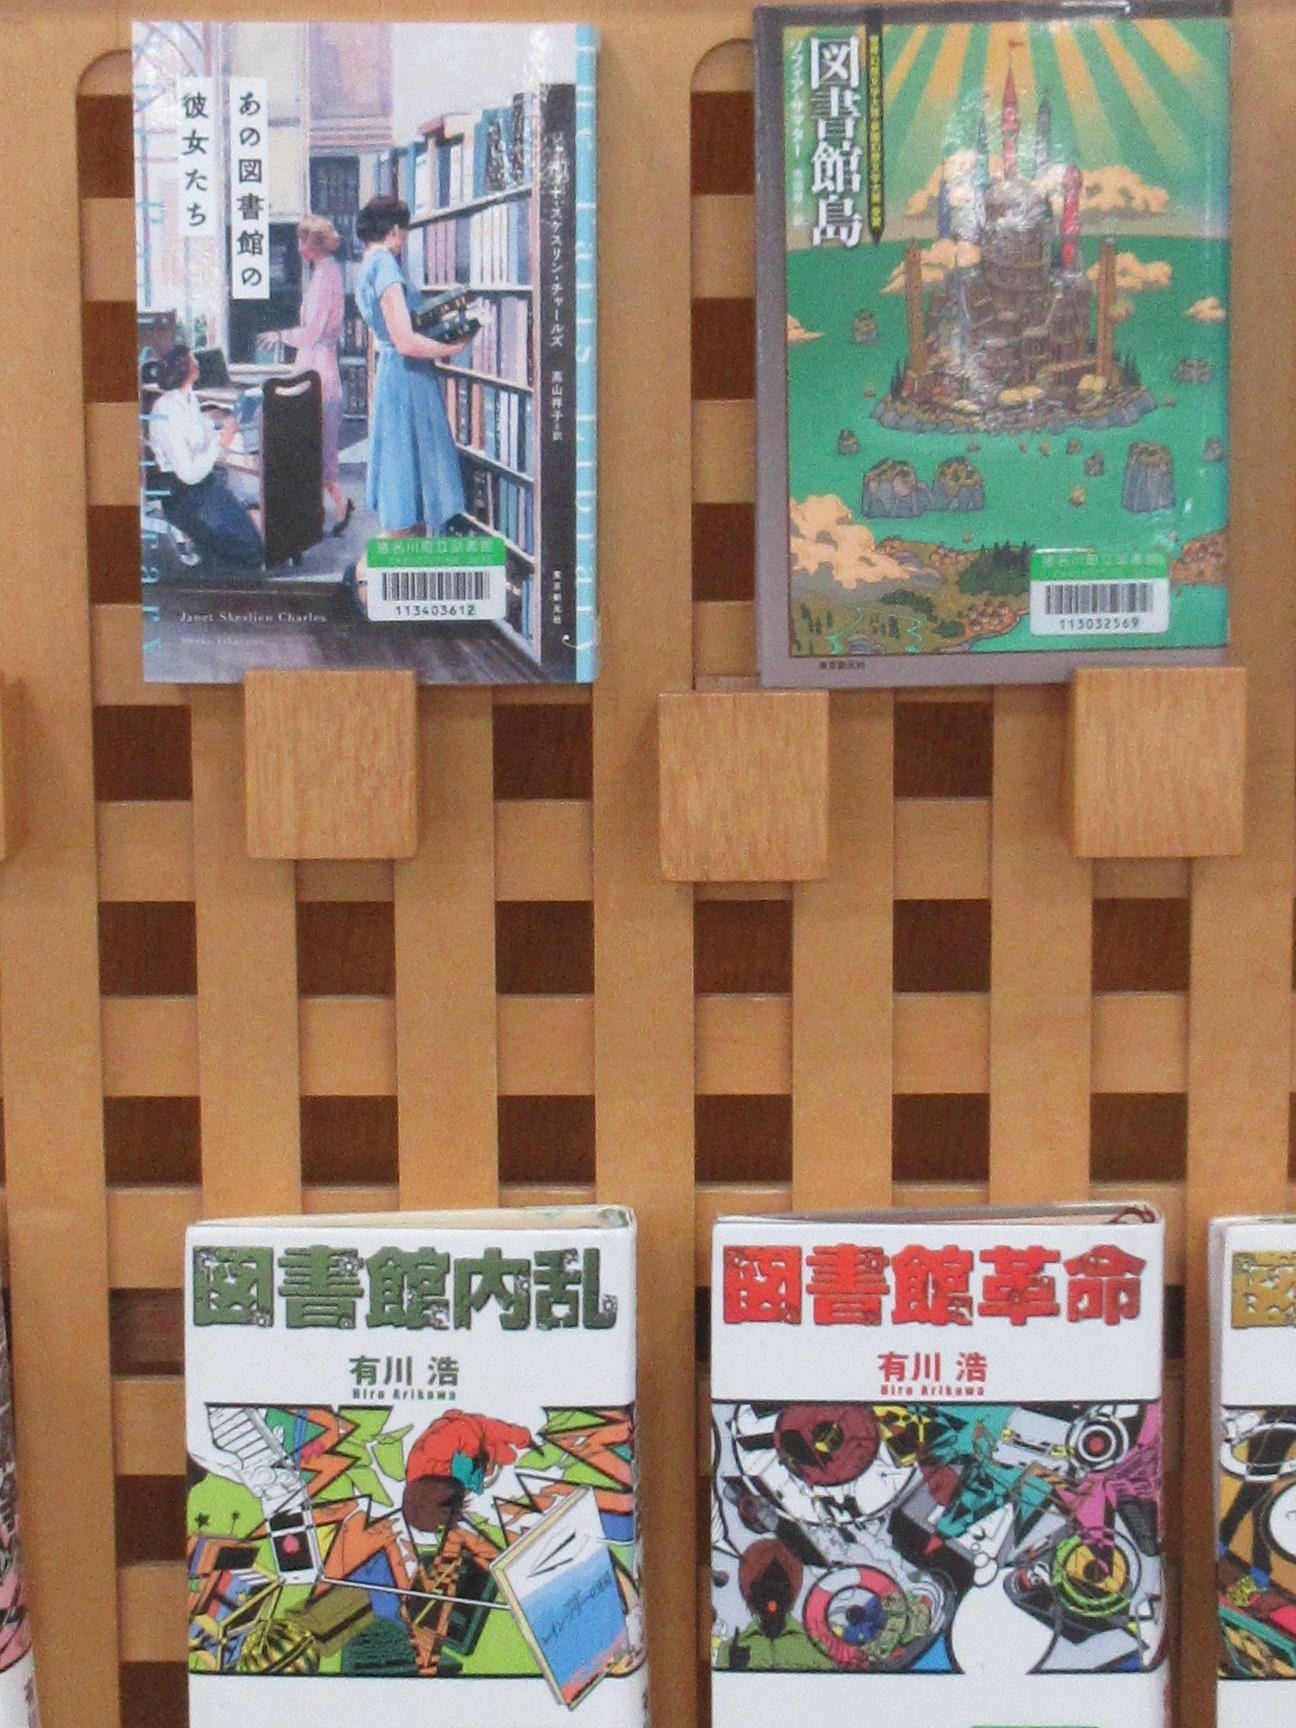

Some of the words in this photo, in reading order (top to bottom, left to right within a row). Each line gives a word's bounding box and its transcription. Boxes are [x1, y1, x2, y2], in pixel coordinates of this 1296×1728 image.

[180, 90, 211, 228] 彼女たち
[809, 35, 863, 249] 図書館島
[236, 90, 265, 288] あの図書館の
[395, 604, 476, 616] 113403612
[1058, 616, 1140, 631] 113032569
[192, 1244, 618, 1332] 図書館内乱
[721, 1244, 1147, 1327] 図書館革命
[348, 1354, 413, 1387] 有川
[427, 1355, 460, 1388] 浩
[877, 1351, 942, 1384] 有川
[955, 1351, 988, 1384] 浩
